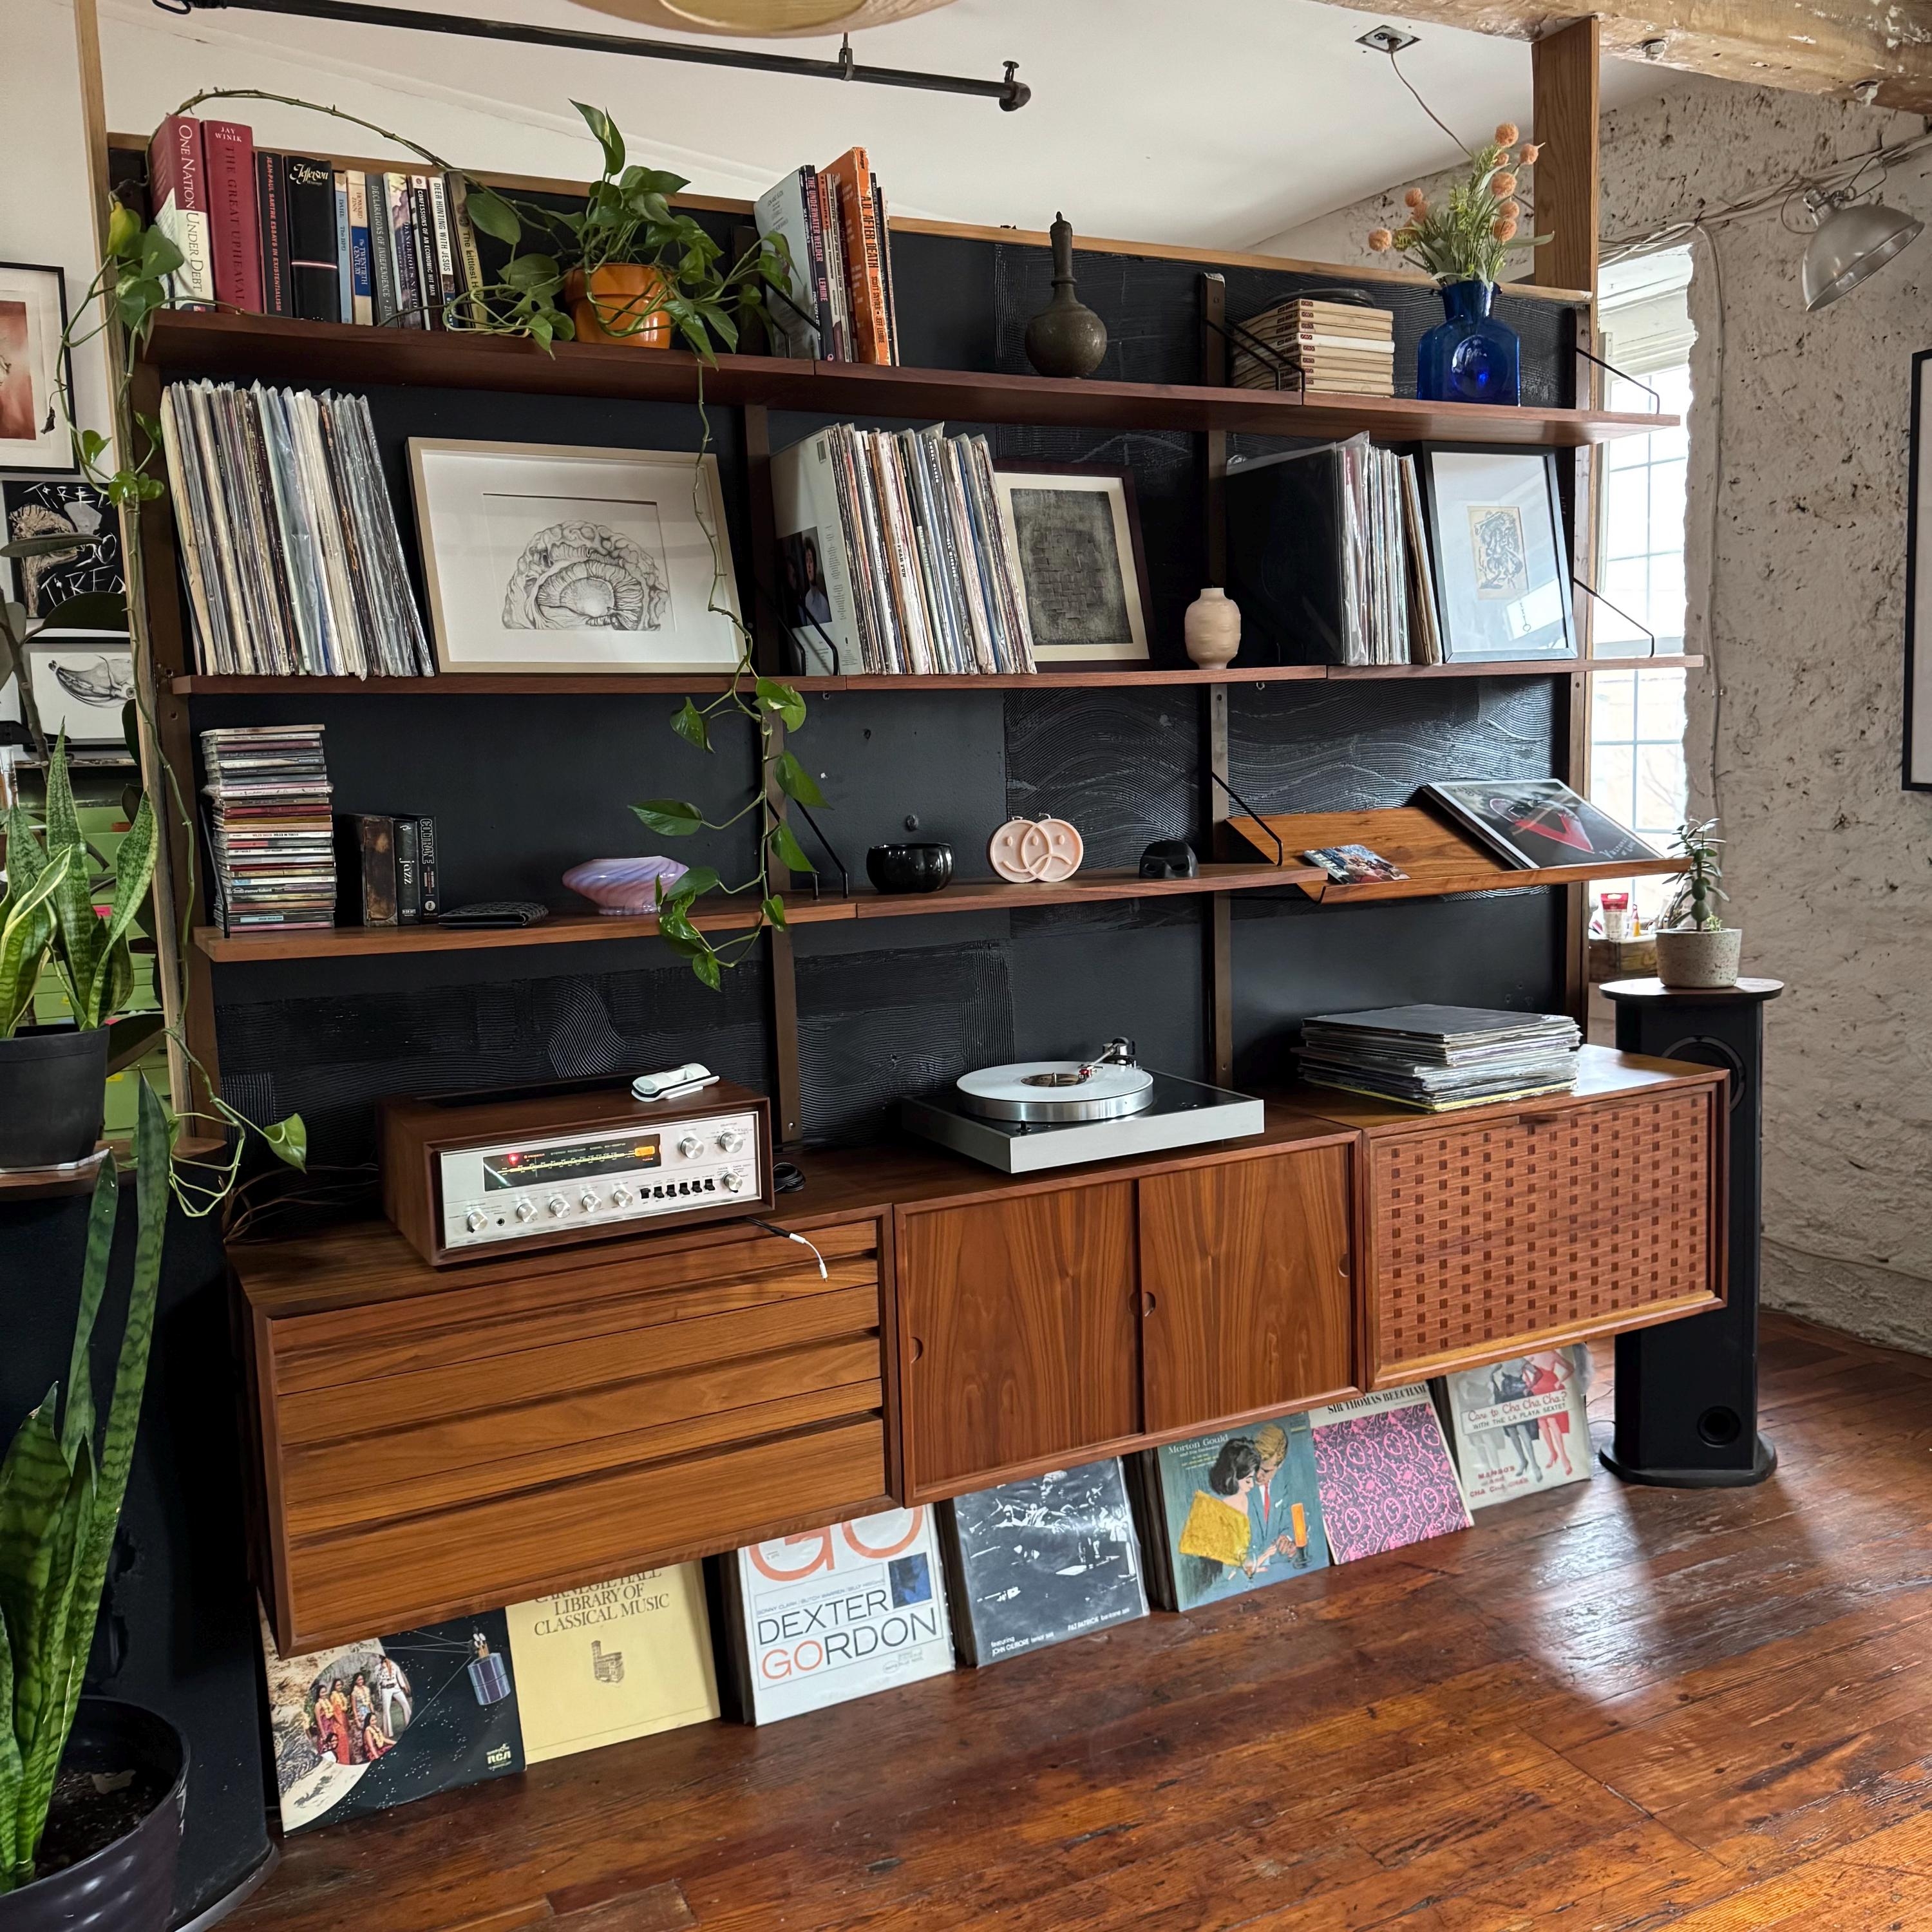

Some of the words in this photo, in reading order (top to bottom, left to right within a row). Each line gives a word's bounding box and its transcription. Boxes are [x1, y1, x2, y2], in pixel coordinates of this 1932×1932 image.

[179, 125, 193, 155] ONE
[214, 133, 242, 142] WINIK
[225, 146, 236, 170] THE
[182, 158, 195, 209] NATION
[267, 156, 276, 190] JEAN-PAUL
[290, 164, 329, 185] Jefferson
[808, 176, 816, 189] THE
[228, 179, 240, 223] GREAT
[268, 191, 278, 218] SARTRE
[371, 185, 384, 234] DECLARATIONS
[418, 190, 428, 227] CONFESSIONS
[435, 201, 446, 229] HUNTING
[809, 189, 820, 233] UNDERWATER
[186, 213, 200, 256] UNDER
[270, 218, 279, 243] ESSAYS
[377, 236, 385, 245] OF
[423, 236, 430, 244] AN
[439, 232, 448, 249] WITH
[862, 214, 875, 240] AFTER
[271, 244, 279, 256] IN
[403, 222, 415, 279] DANGEROUS
[424, 245, 433, 273] ECONOMIC
[442, 251, 451, 271] JESUS
[813, 234, 823, 261] WELDER
[866, 243, 879, 268] DEATH
[191, 260, 204, 292] DEBT
[231, 231, 245, 301] UPHEAVAL
[378, 246, 390, 298] INDEPENDENCE
[272, 256, 282, 312] EXISTENTIALISM
[818, 278, 828, 301] LEMIRE
[421, 819, 435, 864] COLTRANE
[399, 857, 415, 885] jazz
[1327, 1403, 1344, 1414] SIR
[1344, 1396, 1382, 1412] THOMAS
[1383, 1384, 1427, 1402] BEECHAM
[1468, 1410, 1487, 1422] Care
[1491, 1408, 1499, 1417] to
[1502, 1403, 1520, 1414] Cha
[1522, 1398, 1541, 1410] Cha
[1542, 1391, 1567, 1405] Cha?
[1472, 1421, 1490, 1430] WITH
[1520, 1409, 1540, 1418] PLAYA
[1543, 1403, 1566, 1413] SEXTET
[1168, 1441, 1200, 1454] Morton
[1202, 1434, 1229, 1445] Gould
[554, 1587, 621, 1616] LIBRARY
[623, 1582, 645, 1600] OF
[534, 1606, 618, 1636] CLASSICAL
[621, 1593, 670, 1618] MUSIC
[757, 1589, 889, 1645] DEXTER
[1078, 1616, 1100, 1629] PATRICK
[762, 1607, 937, 1680] GORDON
[992, 1646, 1006, 1657] JOHN
[1006, 1638, 1030, 1651] GILMORE
[487, 1750, 511, 1765] RCA
